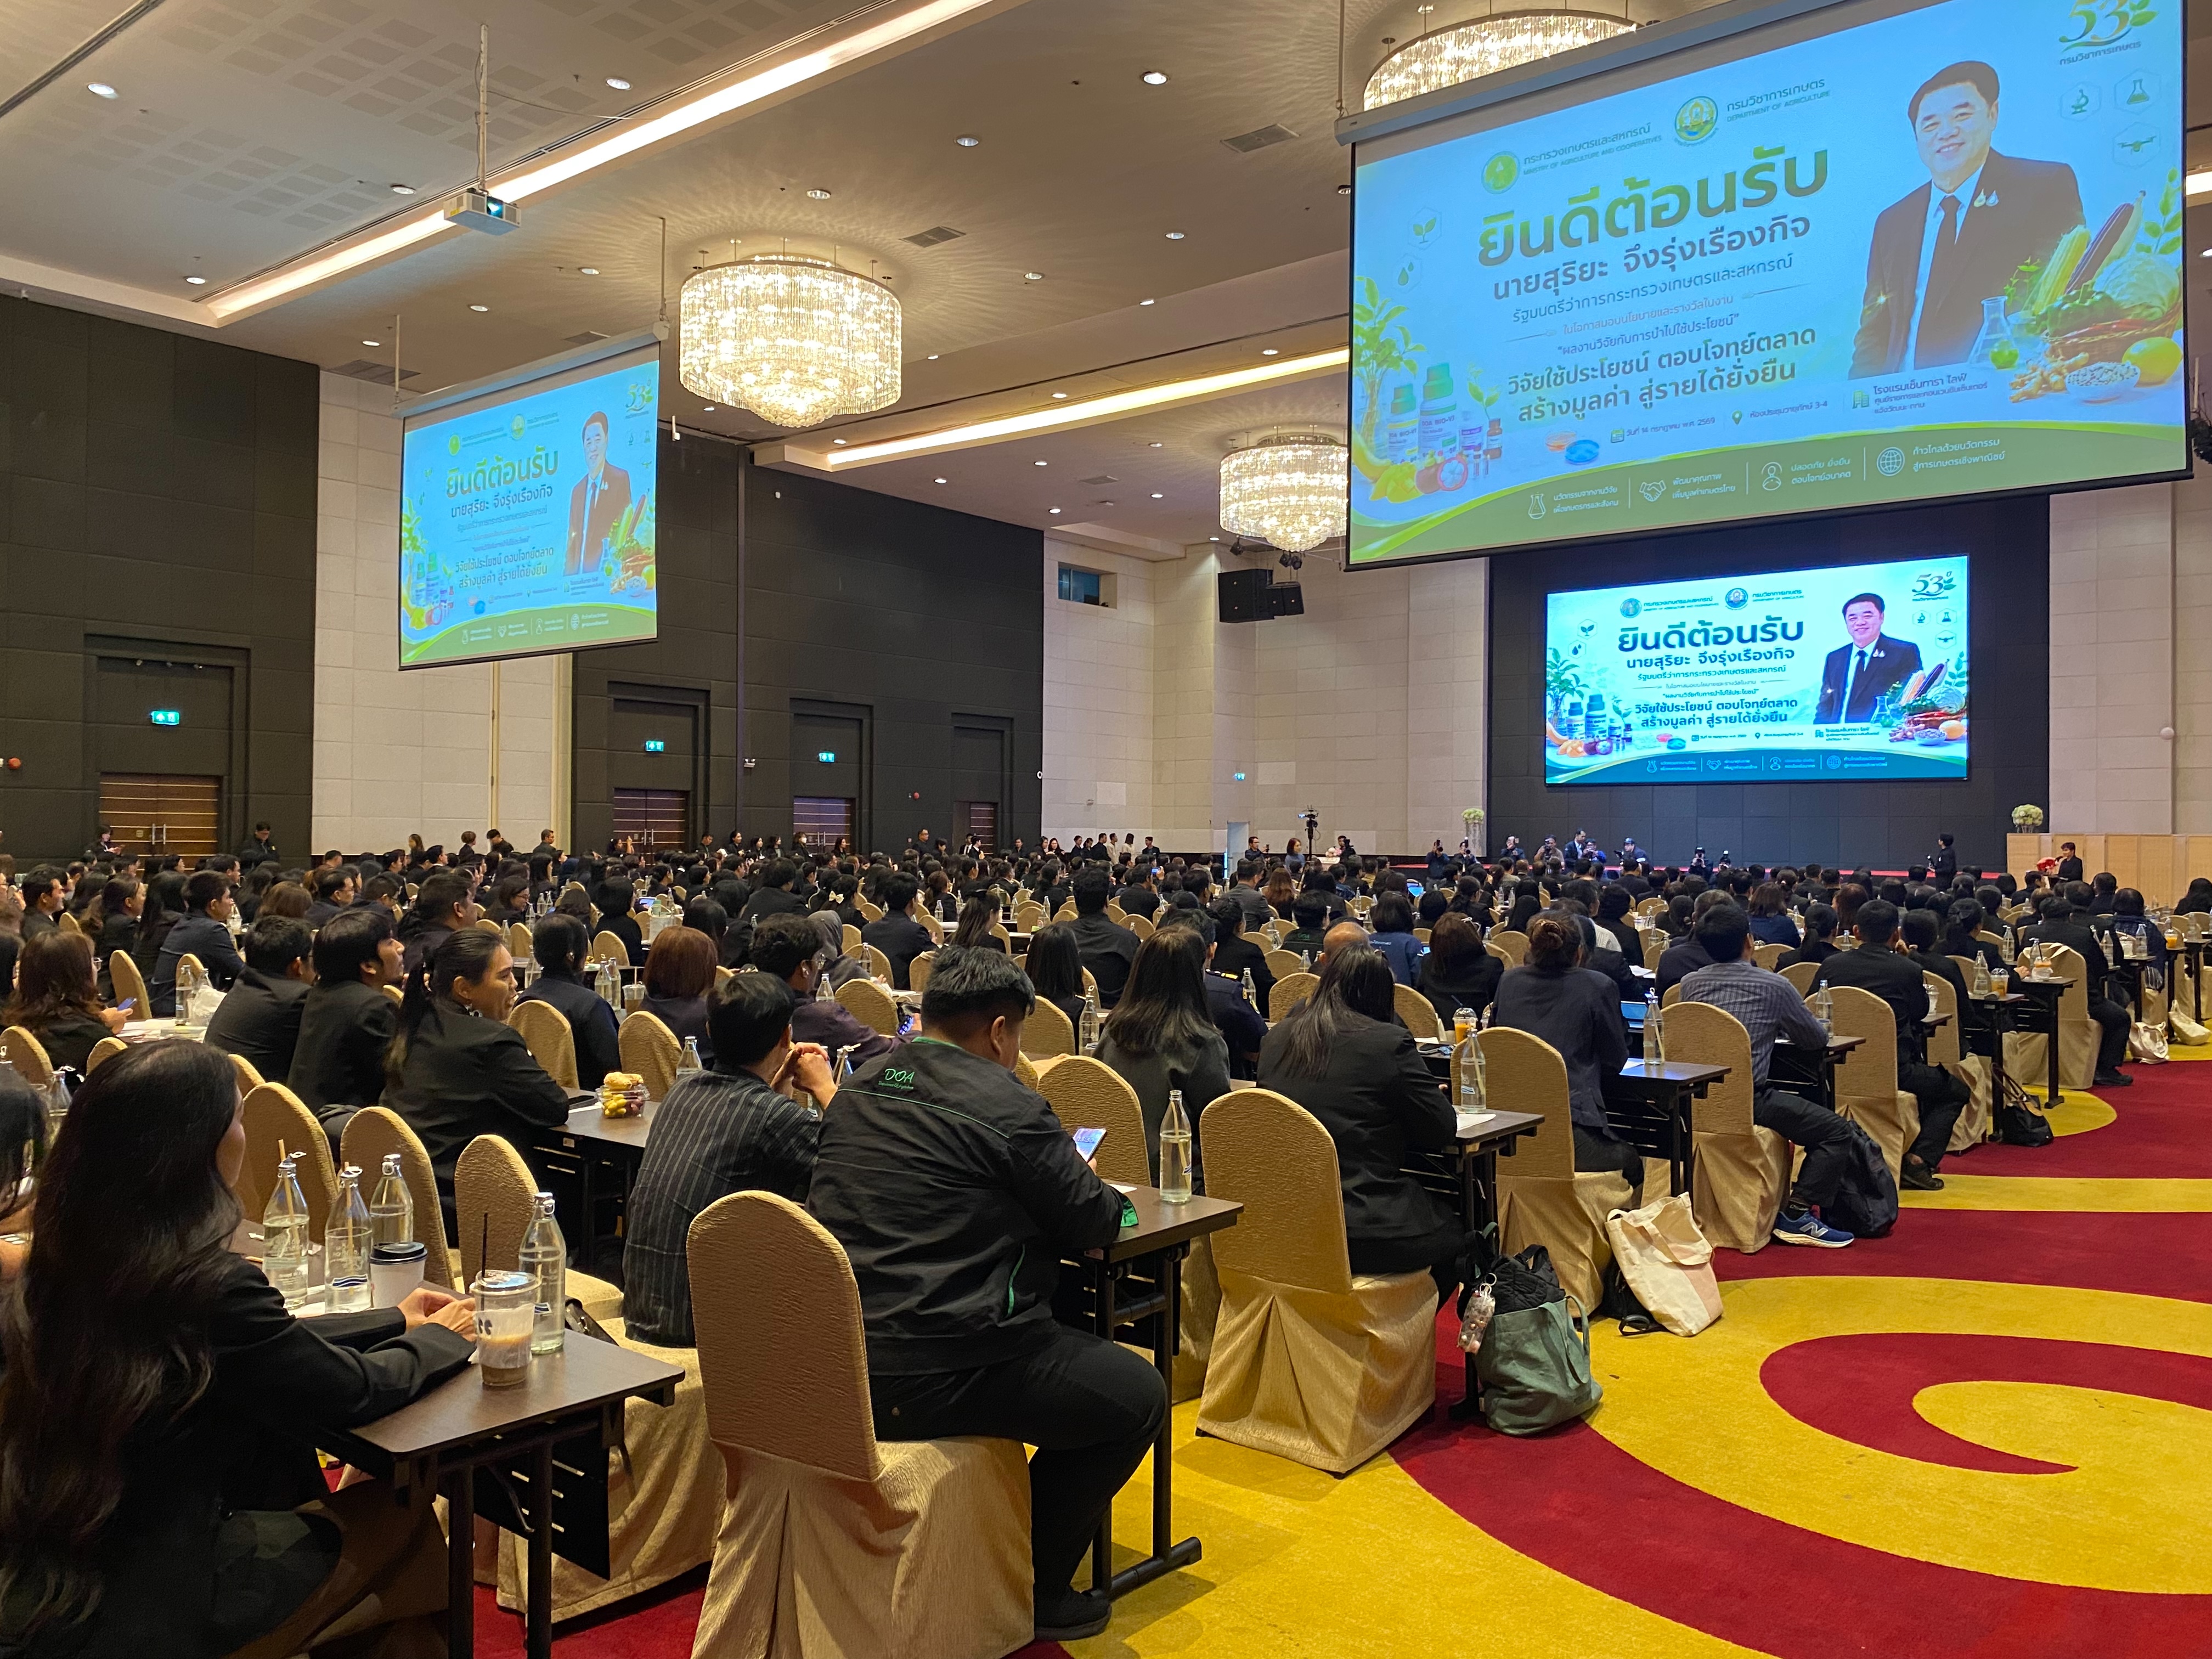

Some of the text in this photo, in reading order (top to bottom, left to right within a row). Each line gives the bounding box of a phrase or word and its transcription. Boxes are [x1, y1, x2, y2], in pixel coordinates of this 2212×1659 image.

[2059, 41, 2141, 65] กรมวิชาการเกษตร
[1726, 79, 1825, 111] กรมวิชาการเกษตร
[1727, 105, 1770, 122] DEPARTMENT
[1784, 91, 1830, 108] AGRICULTURE
[1523, 122, 1651, 165] กระทรวงเกษตรและสหกรณ์
[1523, 163, 1548, 175] MINISTRY
[1560, 151, 1599, 167] AGRICULTURE
[1601, 148, 1614, 156] AND
[1616, 135, 1662, 152] COOPERATIVES
[1478, 145, 1827, 267] ยินดีต้อนรับ
[1493, 214, 1810, 300] นายสุริยะ จึงรุ่งเรืองกิจ
[1513, 253, 1793, 324] รัฐมนตรีว่าการกระทรวงเกษตรและสหกรณ์
[1562, 295, 1734, 335] ในโอกาสมอบนโยบายและรางวัลในงาน
[1508, 328, 1816, 395] วิจัยใช้ประโยชน์ ตอบโจทย์ตลาด
[1518, 357, 1796, 422] สร้างมูลค่า สู่รายได้ยั่งยืน
[1873, 373, 1967, 395] โรงแรมเซ็นทารา ไลฟ์
[1815, 400, 1827, 409] 3-4
[1697, 416, 1715, 426] 2569
[1913, 438, 2000, 456] ก้าวไกลด้วยนวัตกรรม
[447, 444, 558, 498] ยินดีต้อนรับ
[1791, 457, 1850, 472] ปลอดภัย ยั่งยืน
[1912, 451, 2006, 472] สู่การเกษตรเชิงพาณิชย์
[1672, 473, 1722, 486] พัฒนาคุณภาพ
[1791, 470, 1851, 484] ตอบโจทย์อนาคต
[451, 484, 553, 518] นายสุริยะ จึงรุ่งเรืองกิจ
[1553, 486, 1618, 501] นวัตกรรมจากงานวิจัย
[1672, 484, 1736, 500] เพิ่มมูลค่าเกษตรไทย
[1553, 500, 1619, 514] เพื่อเกษตรกรและสังคม
[455, 546, 554, 573] วิจัยใช้ประโยชน์ ตอบโจทย์ตลาด
[459, 571, 496, 589] สร้างมูลค่า
[498, 561, 548, 586] สู่รายได้ยั่งยืน
[1911, 573, 1944, 594] 53
[1618, 615, 1803, 652] ยินดีต้อนรับ
[1627, 647, 1795, 670] นายสุริยะ จึงรุ่งเรืองกิจ
[1638, 665, 1786, 681] รัฐมนตรีว่าการกระทรวงเกษตรและสหกรณ์
[1635, 698, 1798, 714] วิจัยใช้ประโยชน์ ตอบโจทย์ตลาด
[1641, 709, 1788, 729] สร้างมูลค่า สู่รายได้ยั่งยืน
[885, 1068, 915, 1083] DOA
[1799, 1222, 1829, 1238] N
